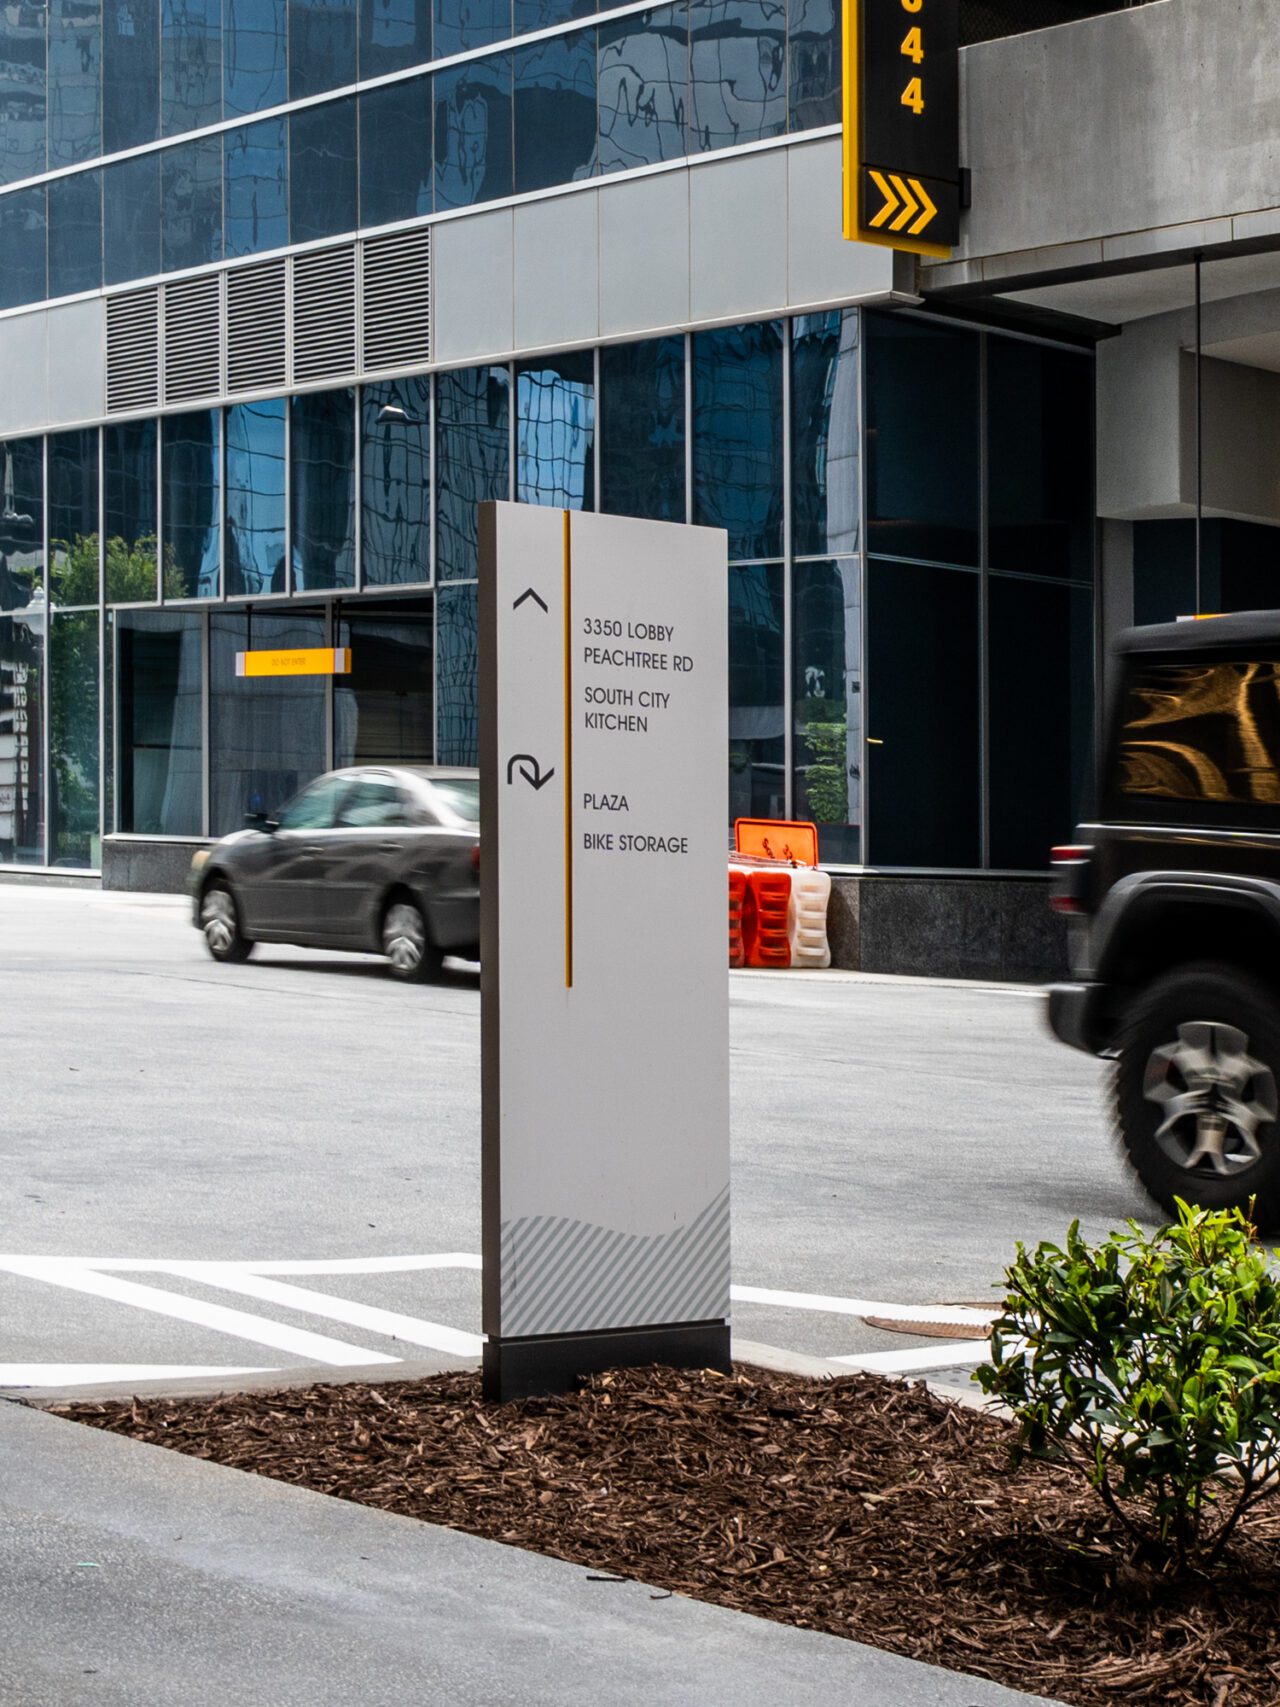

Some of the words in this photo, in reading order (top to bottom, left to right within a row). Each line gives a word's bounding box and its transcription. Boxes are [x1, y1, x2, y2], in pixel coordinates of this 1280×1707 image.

[583, 617, 623, 638] 3350
[627, 621, 675, 642] LOBBY
[584, 647, 668, 671] PEACHTREE
[673, 655, 694, 673] RD
[584, 686, 634, 707] SOUTH
[638, 690, 671, 709] CITY
[584, 712, 648, 733] KITCHEN
[583, 793, 630, 812] PLAZA
[583, 833, 614, 851] BIKE
[618, 834, 689, 854] STORAGE
